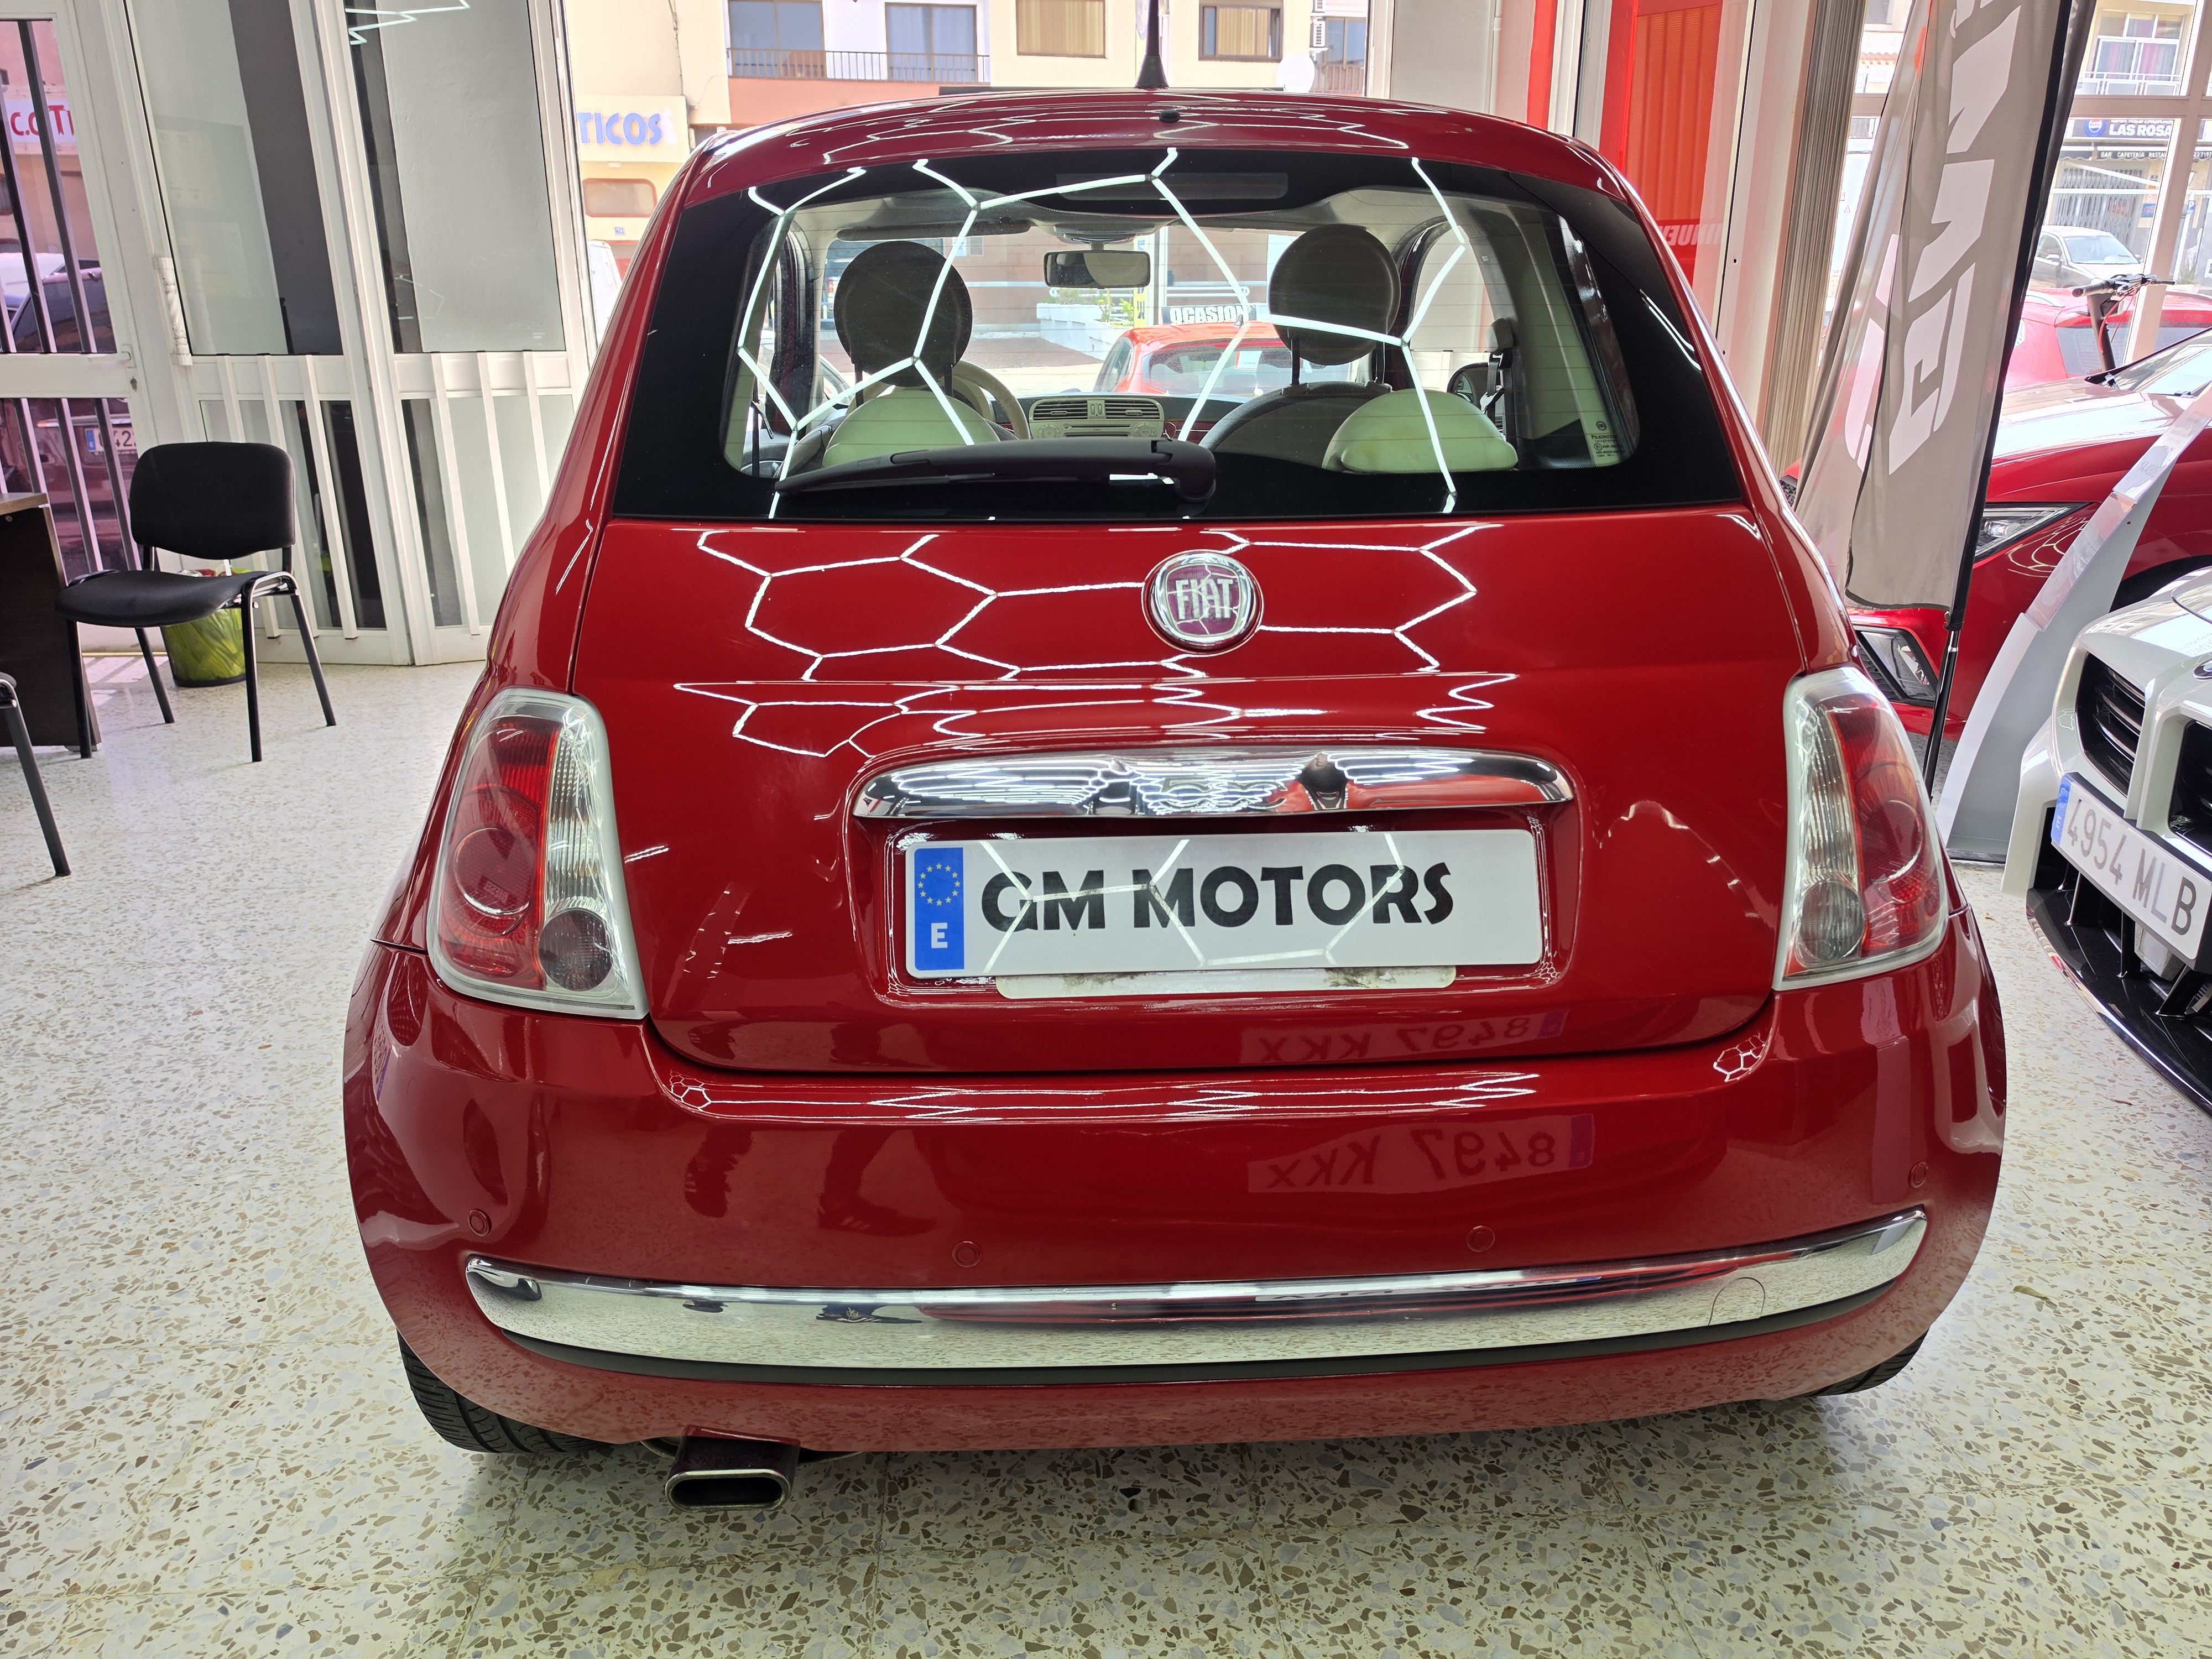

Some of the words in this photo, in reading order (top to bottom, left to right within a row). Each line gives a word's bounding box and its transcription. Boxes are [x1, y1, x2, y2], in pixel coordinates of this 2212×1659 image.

[577, 112, 662, 145] TICOS
[2109, 123, 2136, 136] LAS
[1176, 578, 1233, 619] FIAT
[2056, 815, 2062, 830] E
[2067, 799, 2127, 885] 4954
[2132, 848, 2197, 936] MLB
[982, 870, 1105, 932] GM
[1132, 862, 1453, 927] MOTORS
[931, 922, 948, 948] E
